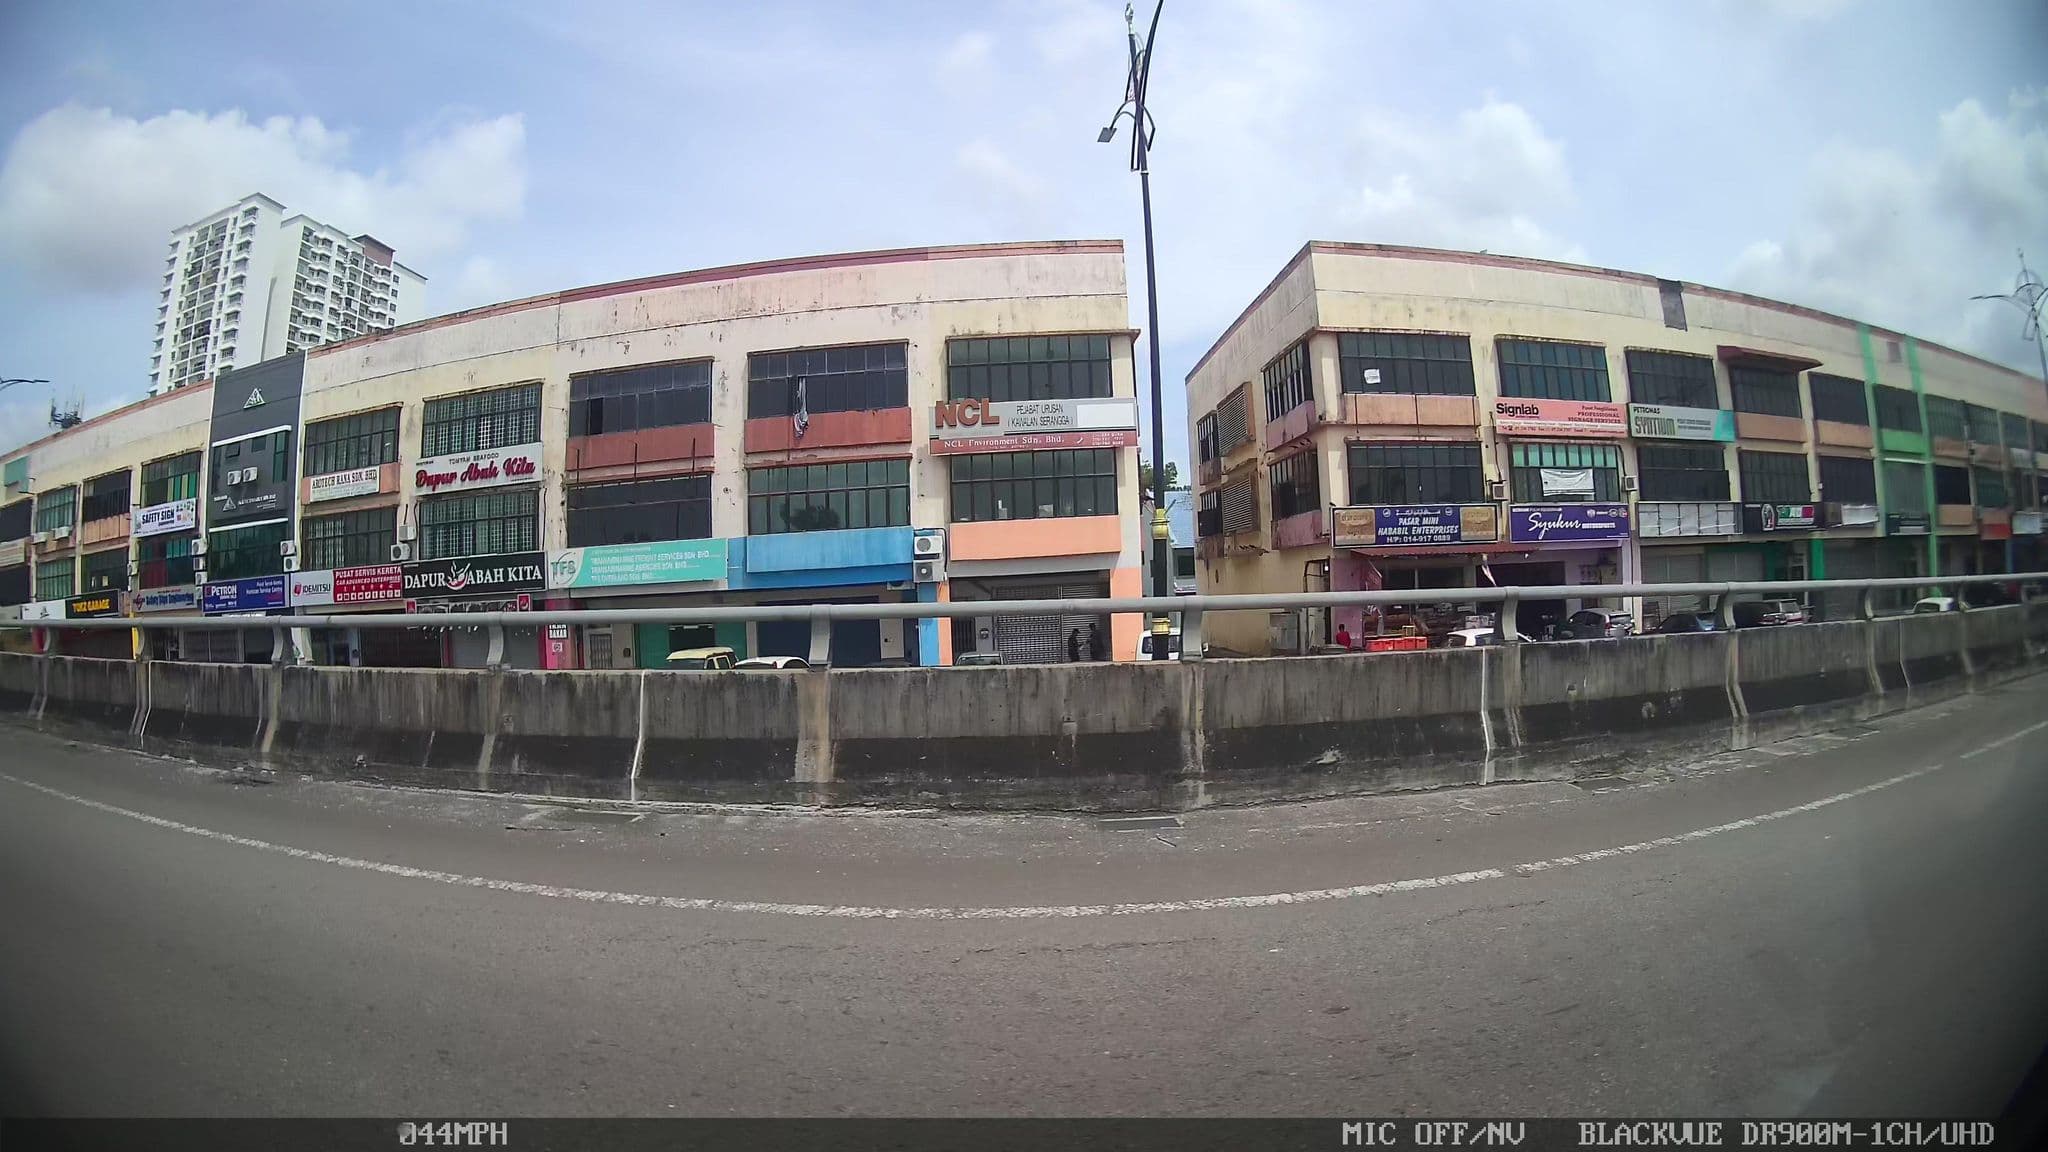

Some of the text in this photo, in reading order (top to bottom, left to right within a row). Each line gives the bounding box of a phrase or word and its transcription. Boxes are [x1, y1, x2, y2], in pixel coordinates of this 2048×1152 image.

[935, 397, 1000, 428] NCL
[1016, 403, 1064, 415] PEJABAT URUSAN
[1496, 403, 1539, 417] Signlab
[1633, 406, 1660, 415] PETRONAS
[944, 440, 964, 448] NCL
[968, 438, 1018, 446] Environment
[1022, 436, 1042, 444] Sdn.
[1045, 434, 1065, 442] Bhd.
[473, 452, 499, 462] SEAFOOD
[415, 469, 457, 491] Dapur
[502, 456, 536, 477] Kita
[160, 507, 175, 521] SIGN
[1398, 516, 1439, 526] PASAR MINI
[1411, 525, 1459, 535] ENTERPRISES
[1528, 512, 1582, 540] Syukur
[335, 570, 354, 579] PUSAT
[354, 568, 376, 577] SERVIS
[376, 565, 402, 575] KERETA
[403, 572, 447, 589] DAPUR
[466, 567, 505, 585] ABAH
[507, 564, 543, 582] KITA
[550, 560, 577, 580] TFS
[211, 583, 237, 597] PETRON
[302, 583, 331, 594] IDEMITSU
